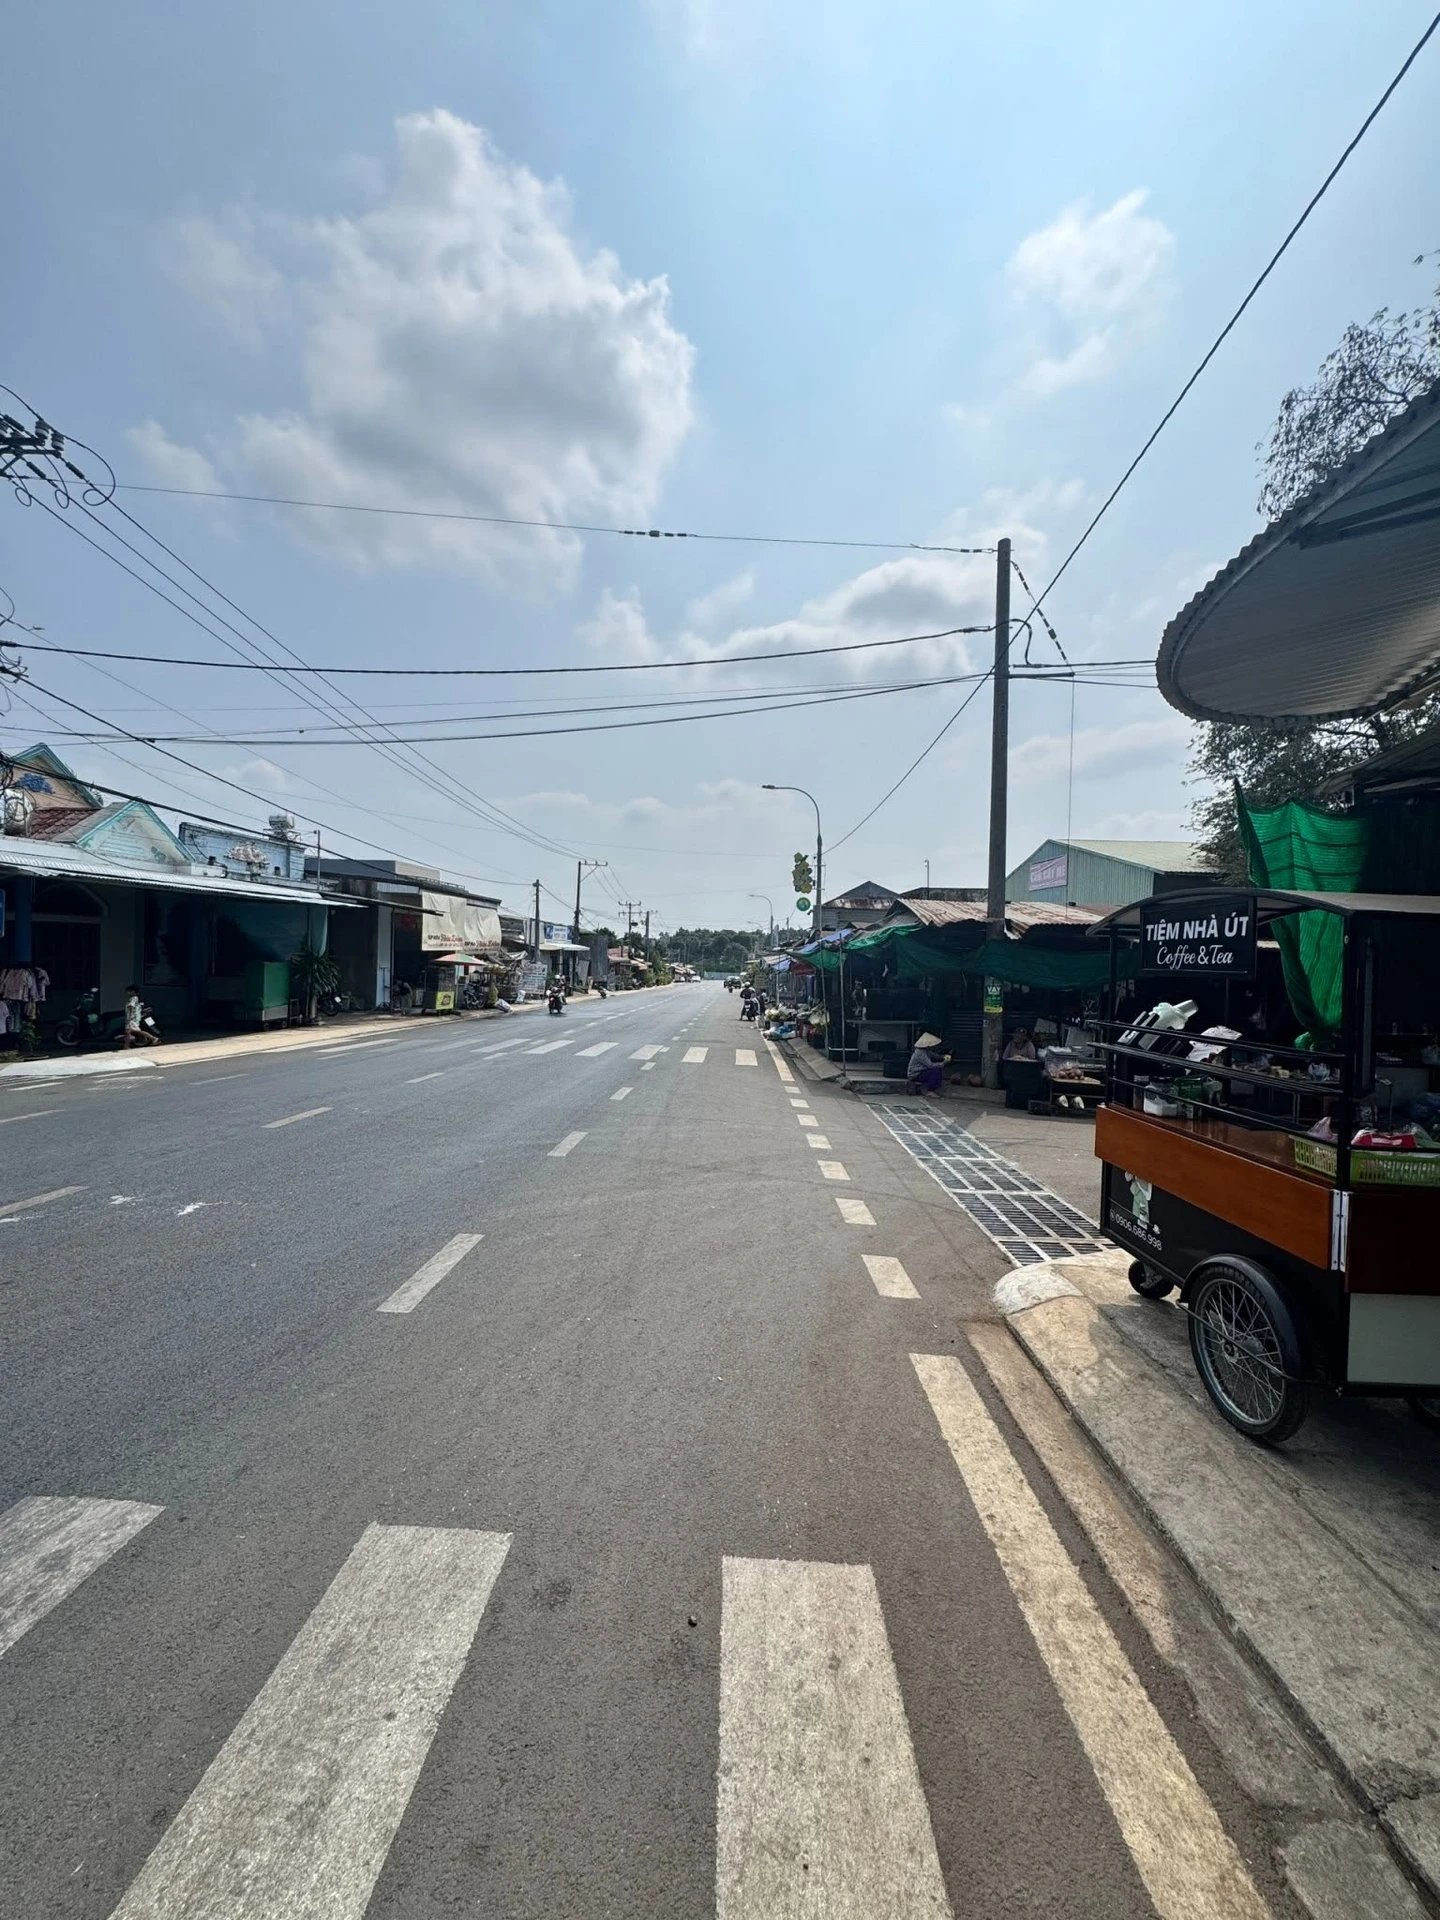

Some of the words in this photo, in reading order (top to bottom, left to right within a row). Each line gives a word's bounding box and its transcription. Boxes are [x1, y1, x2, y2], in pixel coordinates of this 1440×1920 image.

[1145, 918, 1180, 946] TIỆM
[1182, 913, 1219, 940] NHÀ
[1224, 911, 1249, 938] ÚT
[1156, 944, 1197, 971] Coffee
[1209, 944, 1234, 965] Tea
